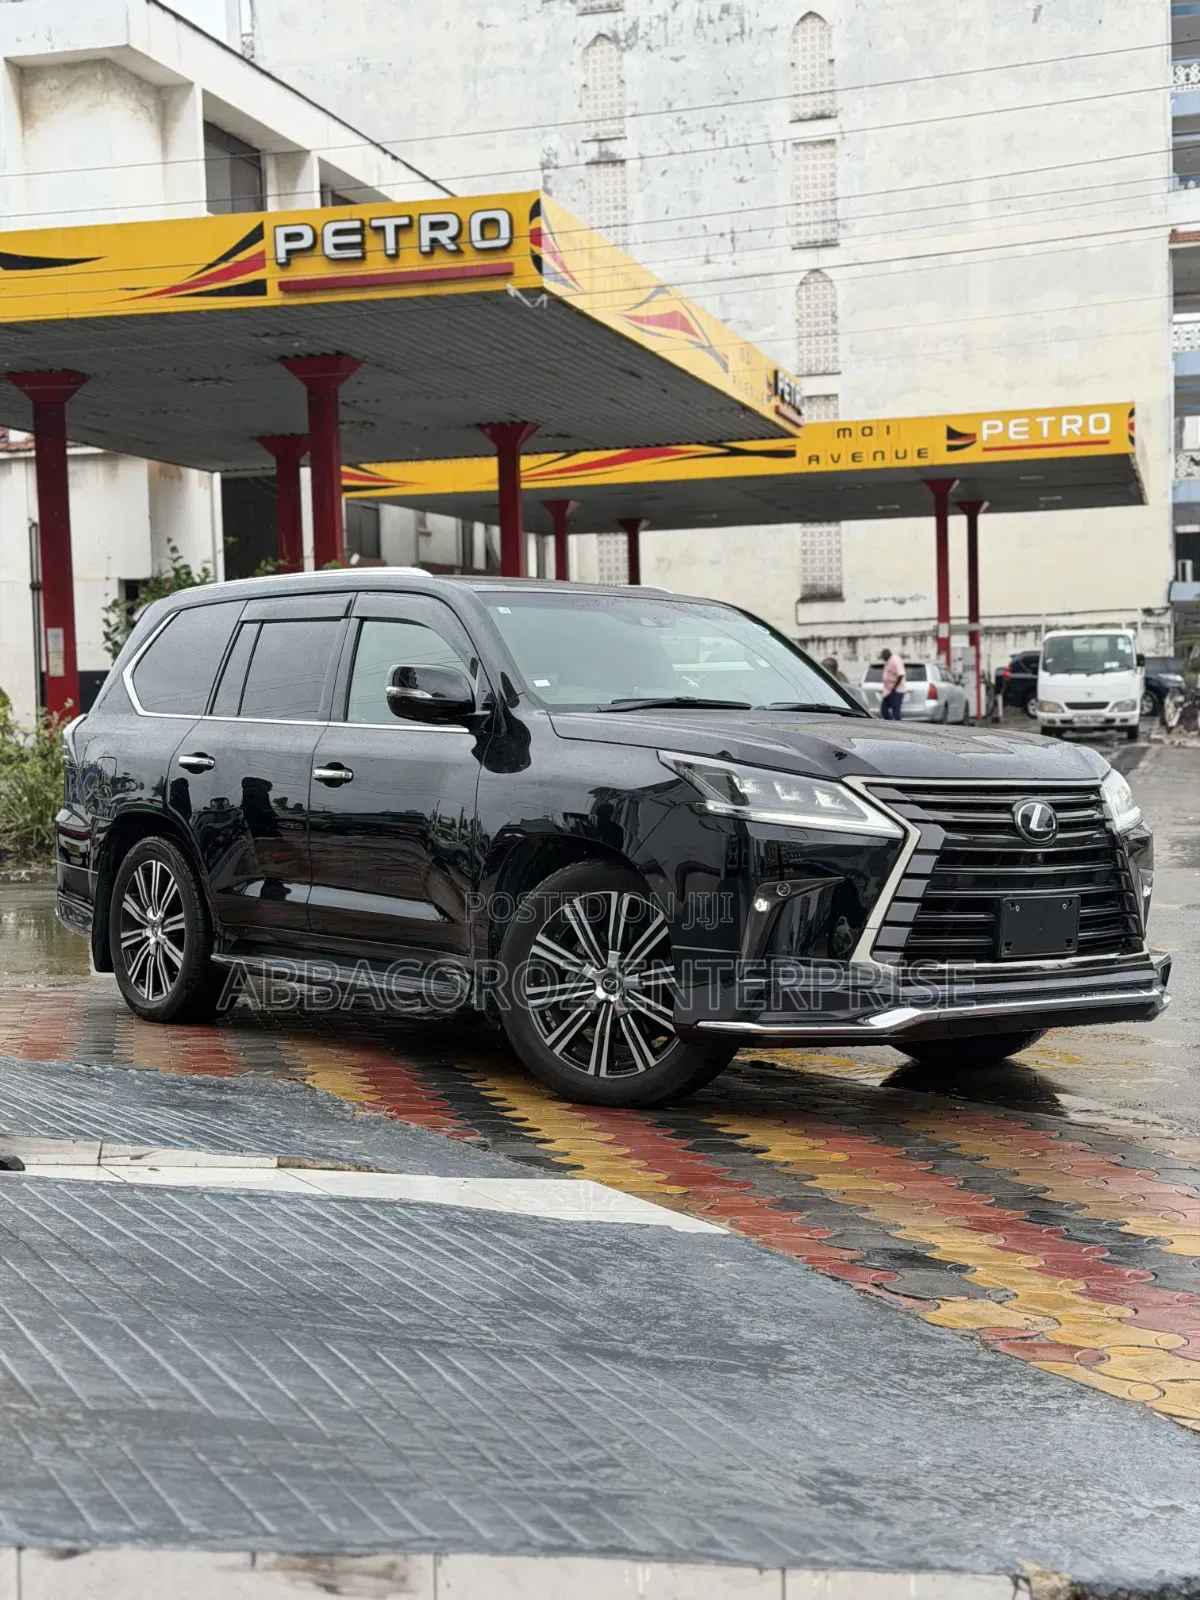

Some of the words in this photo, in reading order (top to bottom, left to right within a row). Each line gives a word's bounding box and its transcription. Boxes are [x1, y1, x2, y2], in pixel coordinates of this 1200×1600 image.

[273, 207, 515, 266] PETRO
[836, 424, 890, 439] MOI
[981, 412, 1111, 442] PETRO
[807, 447, 929, 466] AVENUE
